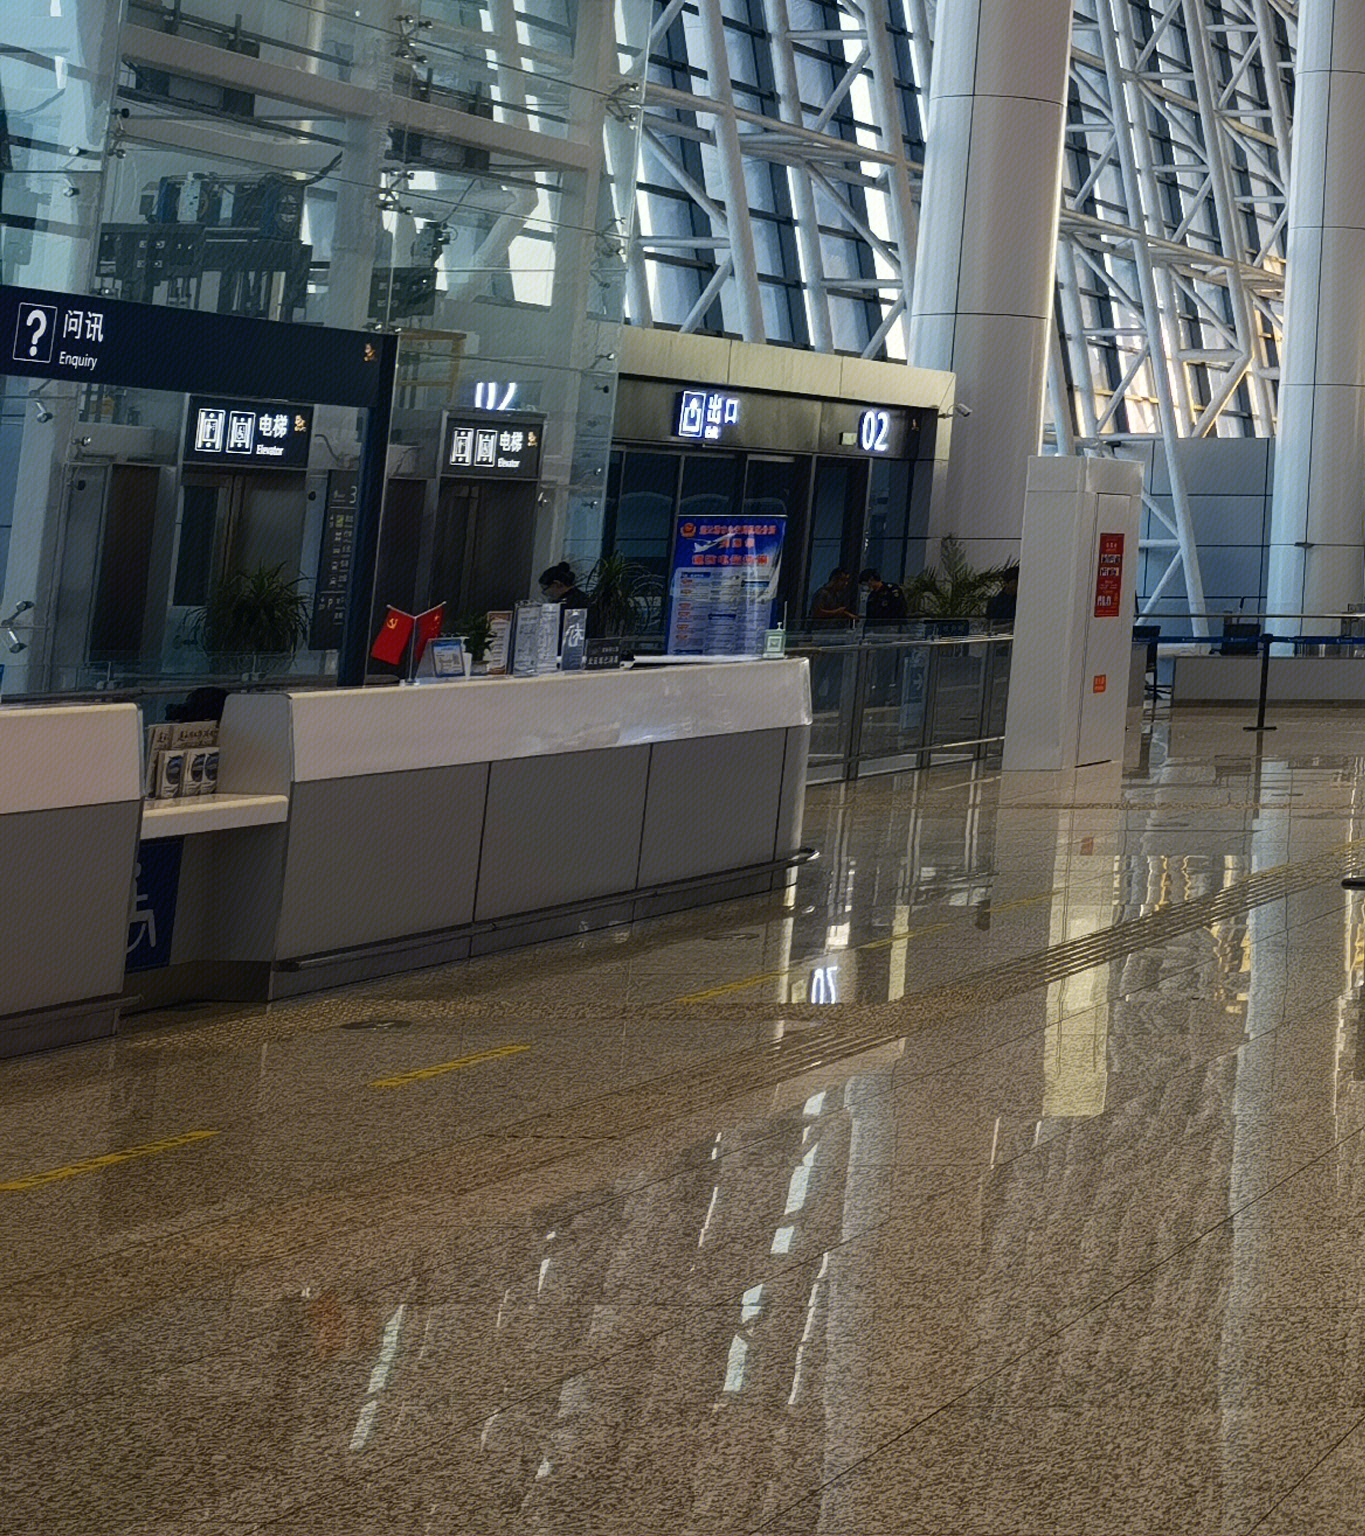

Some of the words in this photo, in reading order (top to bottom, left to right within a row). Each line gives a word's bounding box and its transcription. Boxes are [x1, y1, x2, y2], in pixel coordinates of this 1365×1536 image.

[62, 310, 105, 342] 问讯
[59, 351, 98, 370] Enquiry
[706, 394, 739, 424] 出口
[258, 413, 289, 440] 电梯
[861, 410, 890, 451] 02
[499, 431, 523, 453] 电梯
